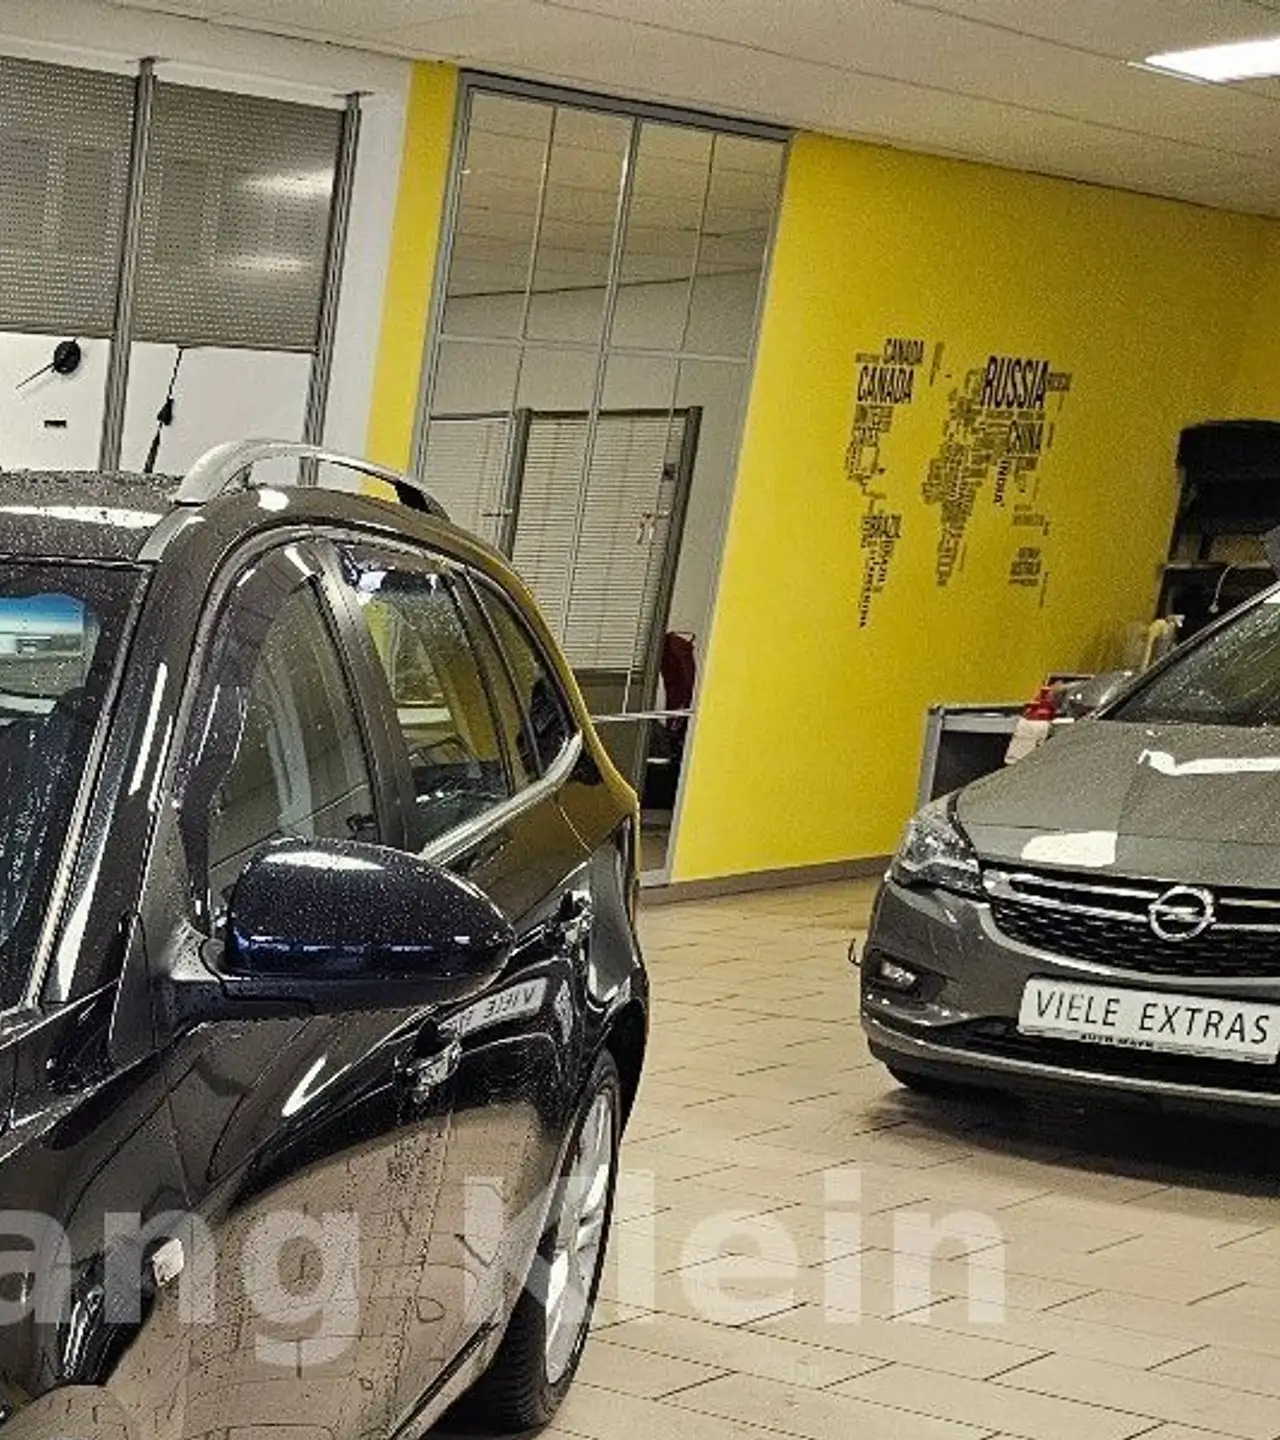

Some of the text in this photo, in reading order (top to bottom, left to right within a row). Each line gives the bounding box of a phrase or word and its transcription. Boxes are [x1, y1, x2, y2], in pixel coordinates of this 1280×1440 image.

[857, 365, 914, 405] CANADA
[980, 355, 1050, 409] RUSSIA
[1036, 989, 1270, 1044] VIELE EXTRAS
